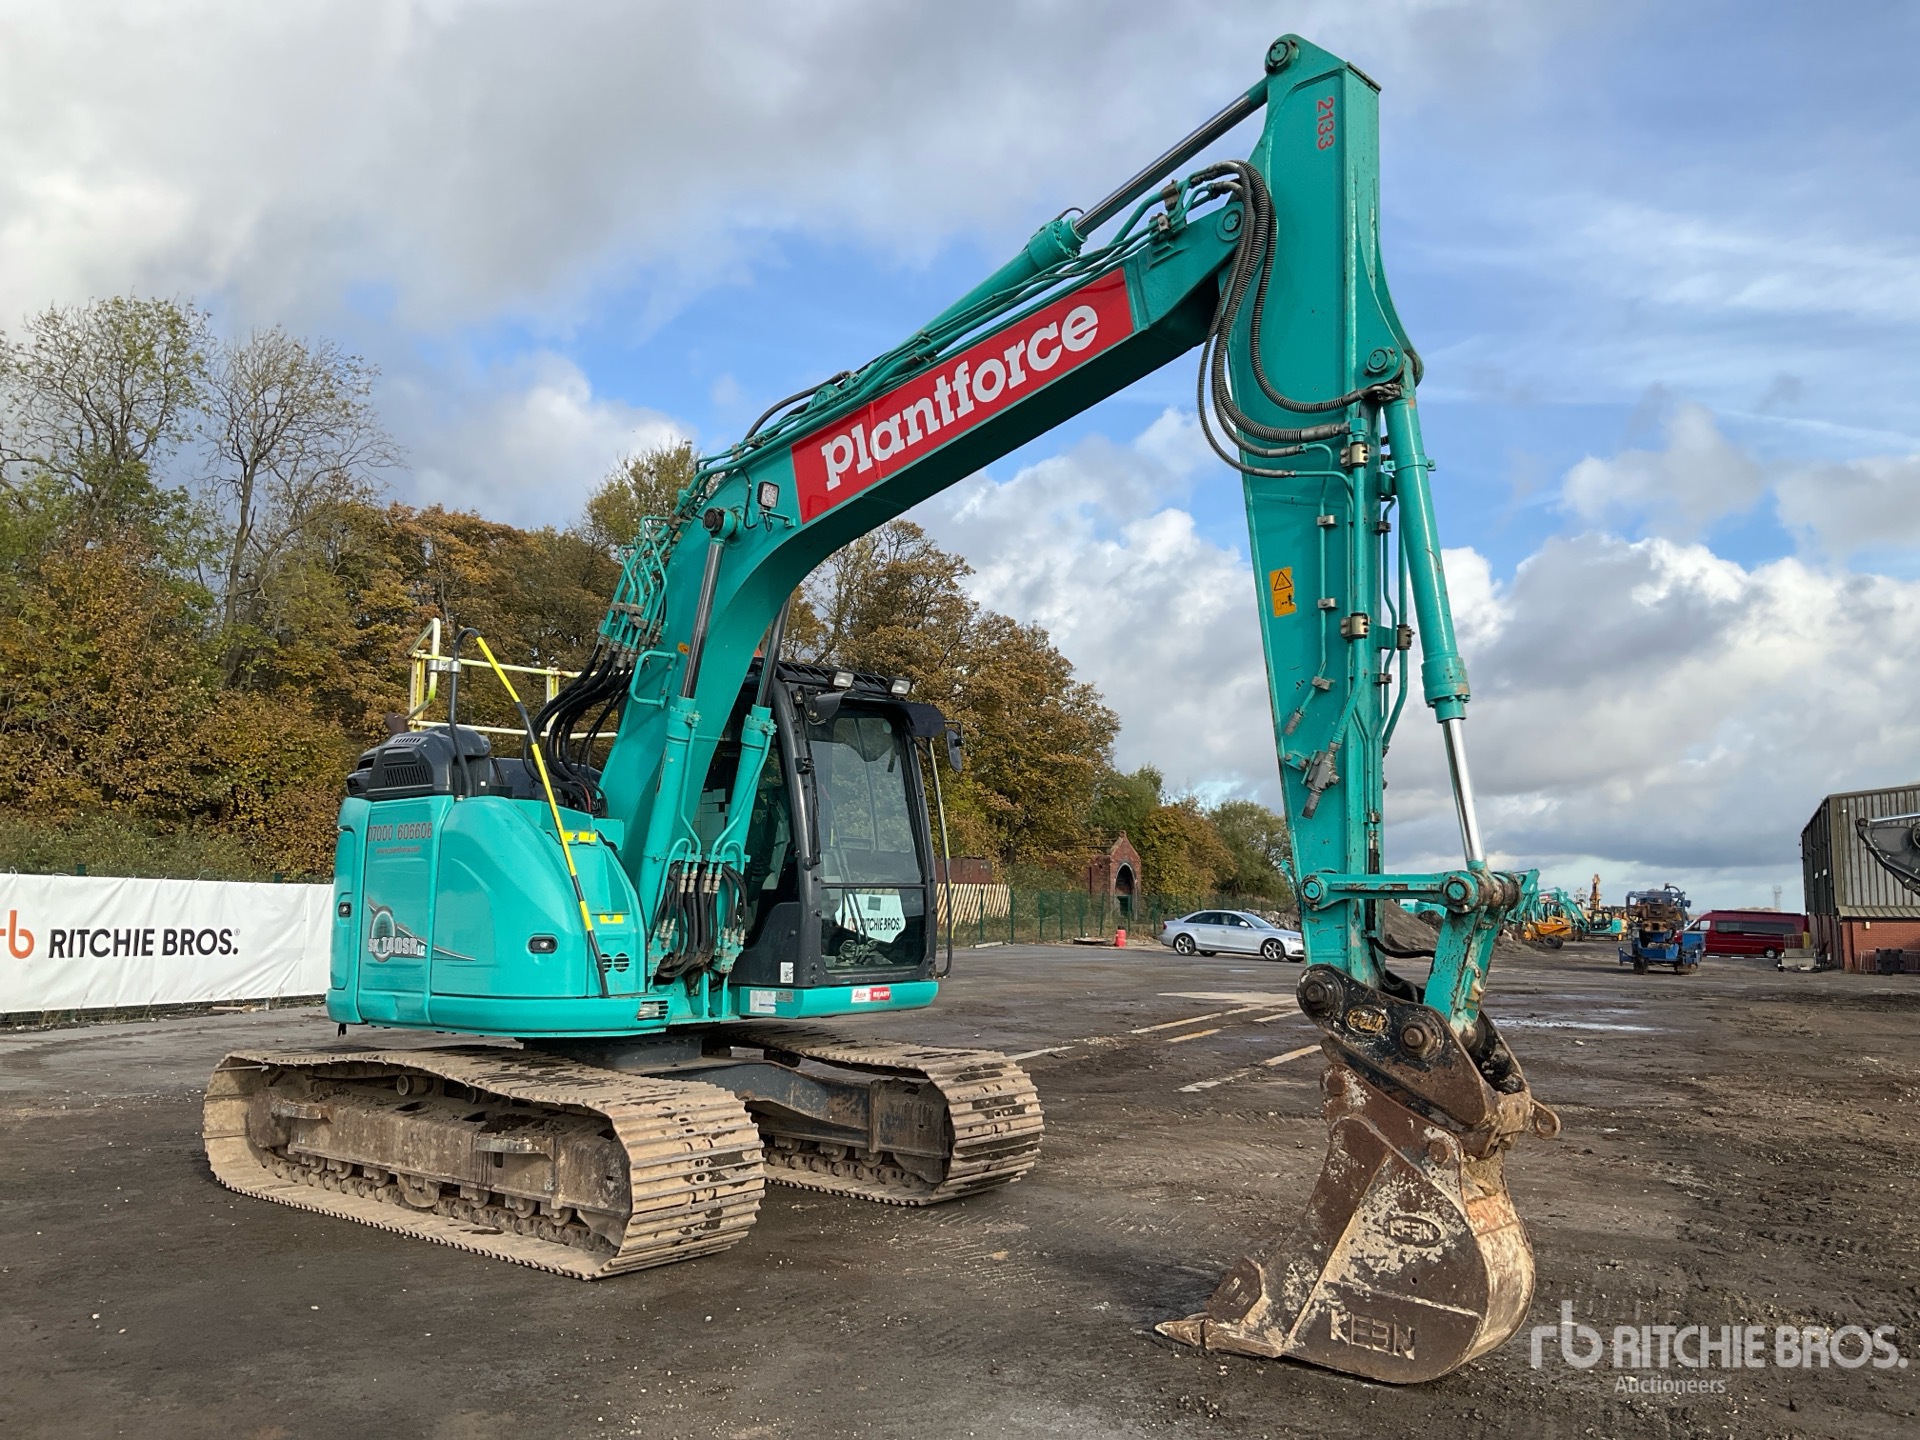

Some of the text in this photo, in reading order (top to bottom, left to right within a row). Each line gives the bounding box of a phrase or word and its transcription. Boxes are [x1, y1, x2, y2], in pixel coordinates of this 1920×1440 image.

[1317, 96, 1335, 150] 2133
[820, 304, 1099, 492] plantforce
[398, 822, 432, 839] 606606
[48, 928, 155, 958] RITCHIE
[1331, 1308, 1415, 1360] KEEN
